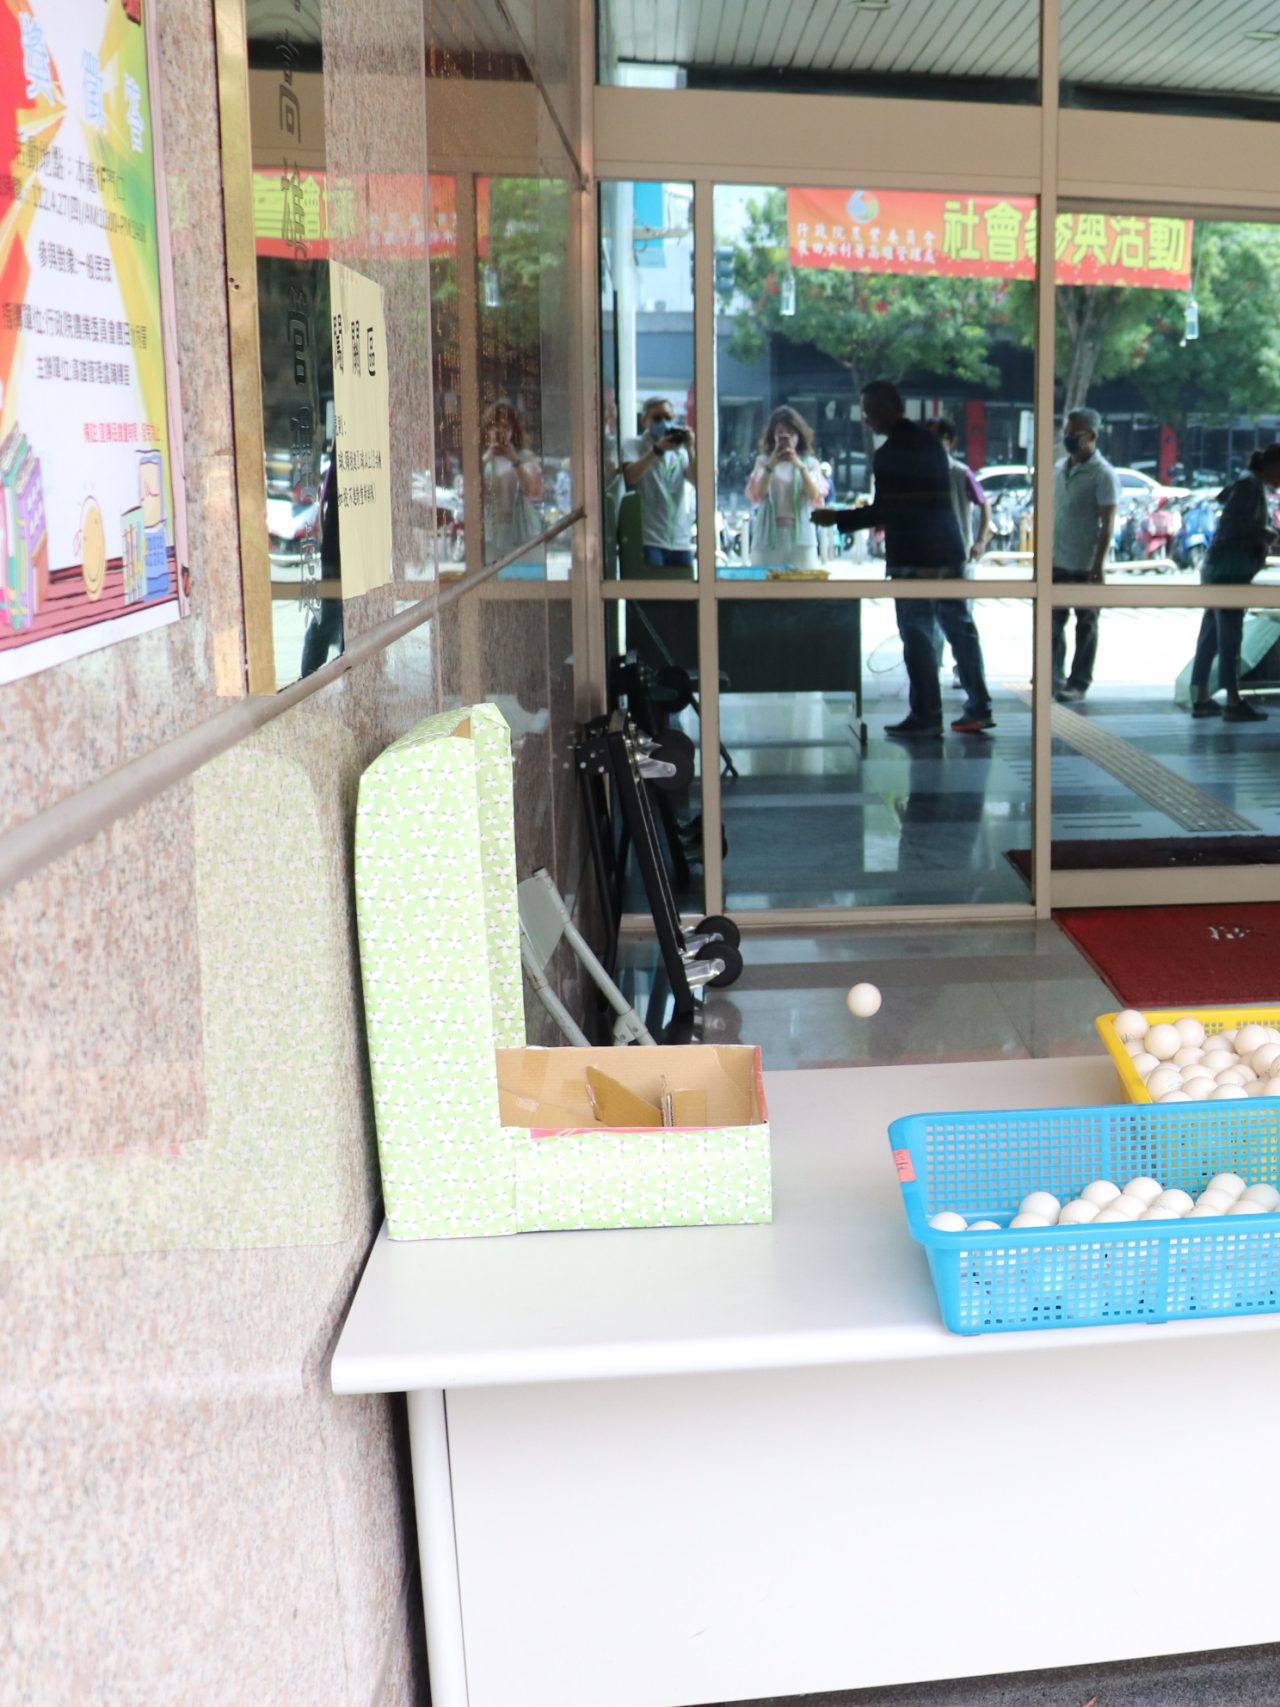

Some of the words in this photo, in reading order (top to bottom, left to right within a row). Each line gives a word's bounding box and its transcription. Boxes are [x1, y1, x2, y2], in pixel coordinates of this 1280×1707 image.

[276, 0, 322, 626] 高雄管理處
